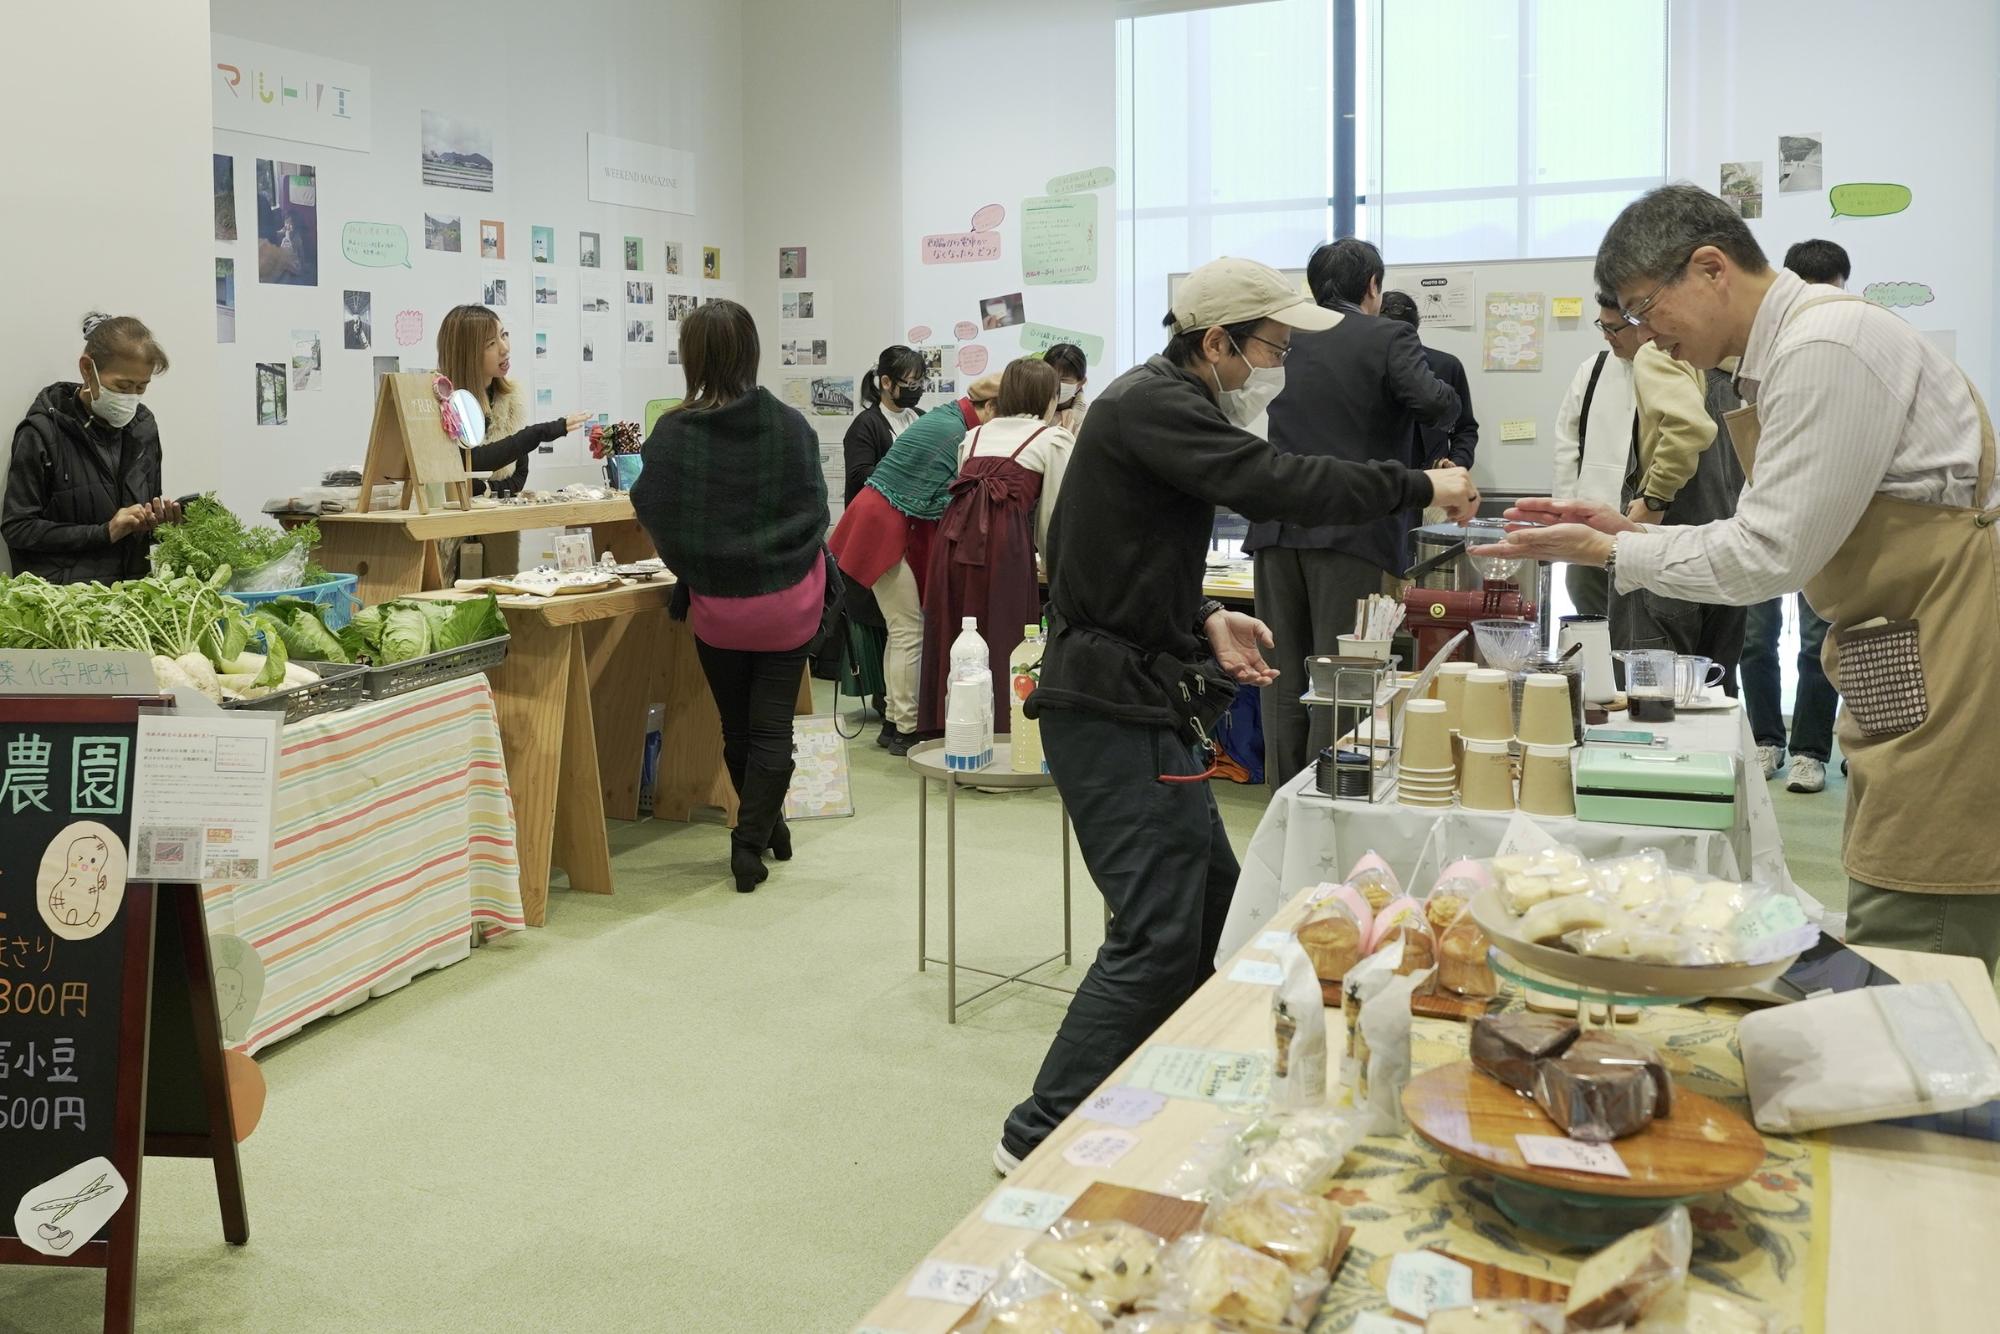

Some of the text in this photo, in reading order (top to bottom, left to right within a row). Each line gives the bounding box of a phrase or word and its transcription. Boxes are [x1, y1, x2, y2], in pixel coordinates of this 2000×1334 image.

[604, 167, 678, 189] WEEKEND MAGAZINE
[0, 733, 130, 815] 農園
